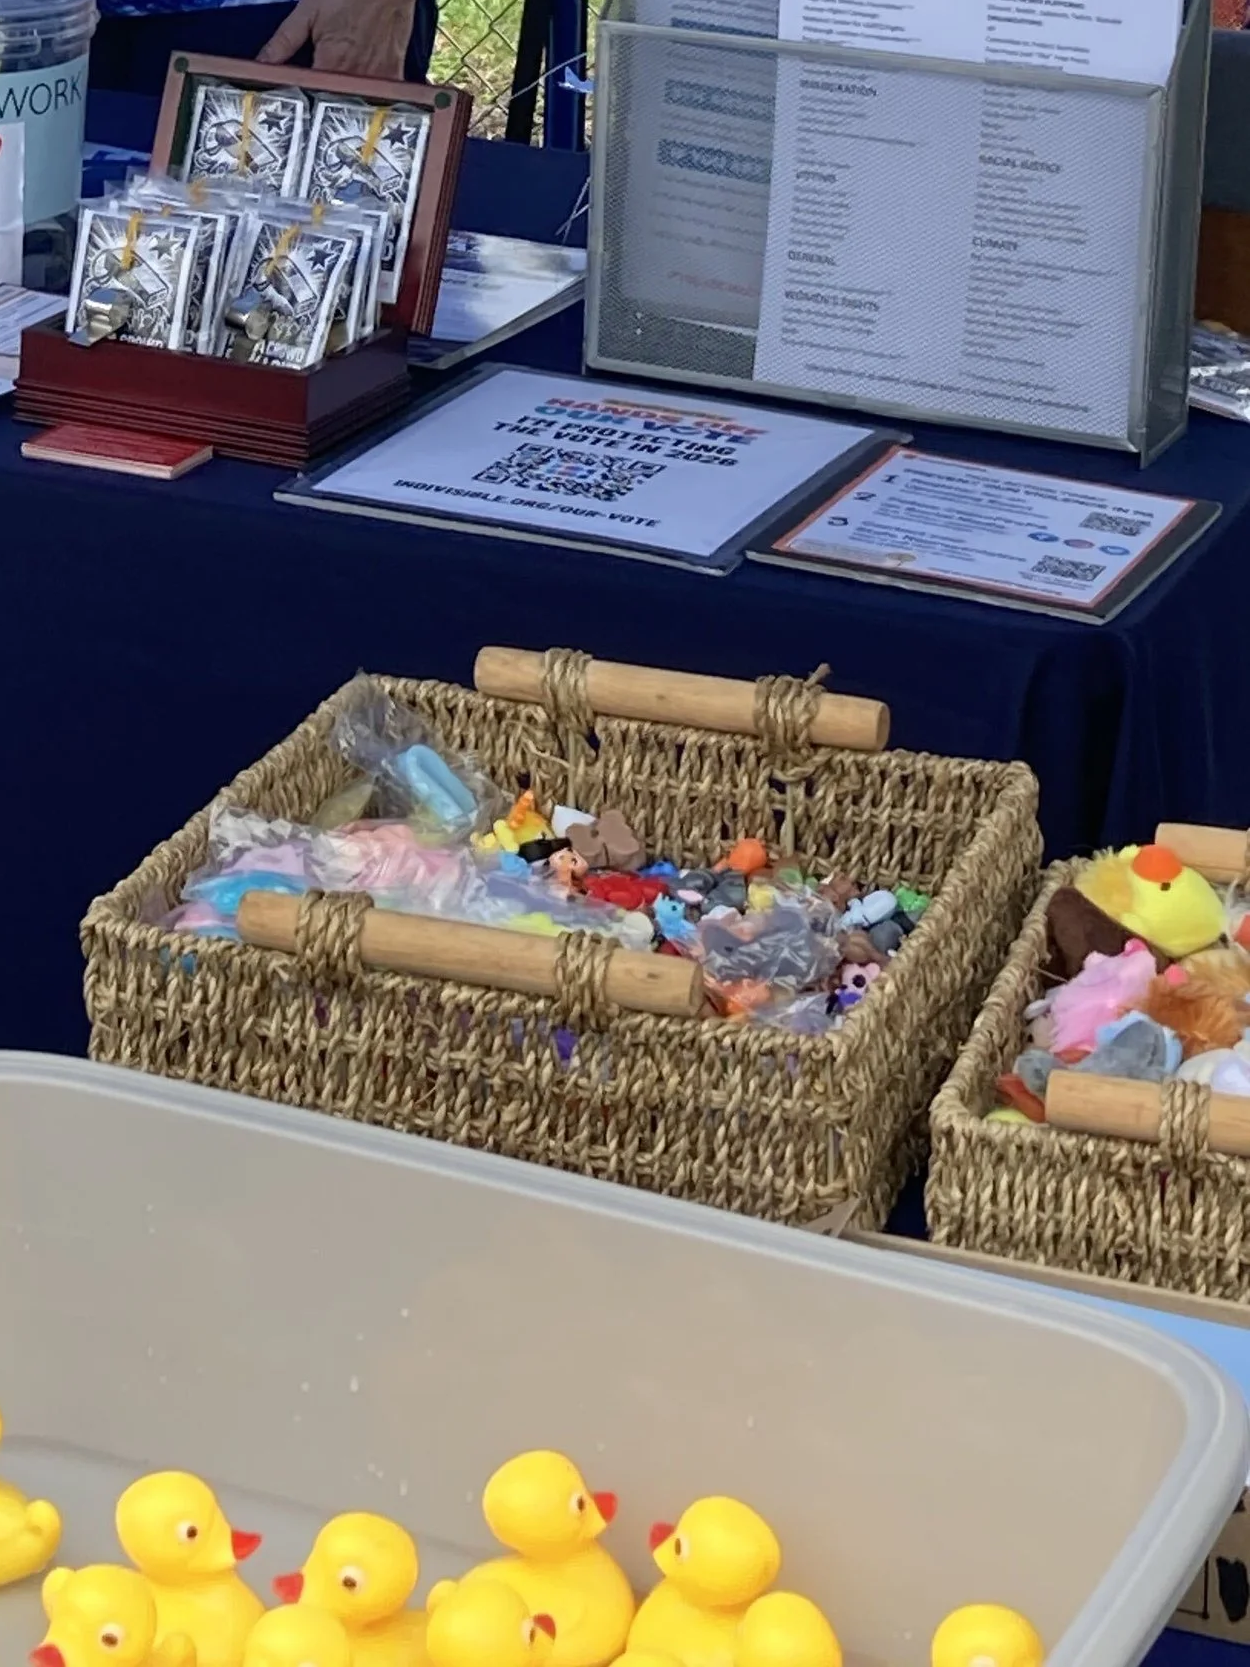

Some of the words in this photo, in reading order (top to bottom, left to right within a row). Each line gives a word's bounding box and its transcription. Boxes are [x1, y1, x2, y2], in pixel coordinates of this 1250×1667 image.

[492, 421, 548, 436] THE
[553, 430, 625, 448] VOTE
[628, 443, 663, 455] IN
[559, 422, 737, 456] PROTECTING
